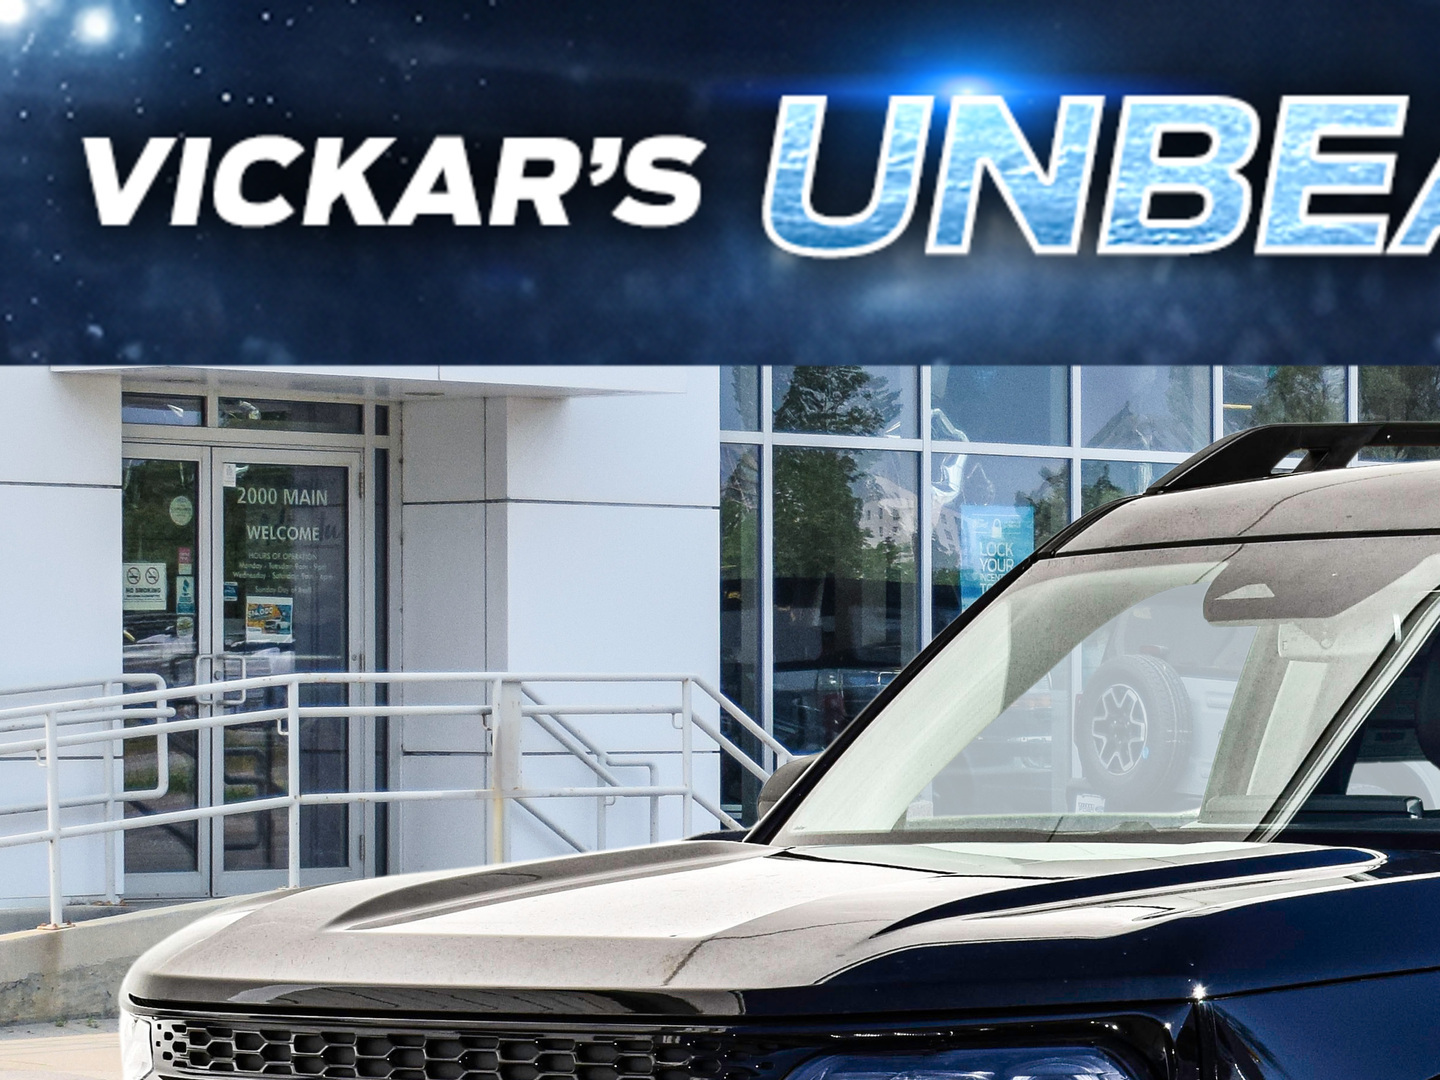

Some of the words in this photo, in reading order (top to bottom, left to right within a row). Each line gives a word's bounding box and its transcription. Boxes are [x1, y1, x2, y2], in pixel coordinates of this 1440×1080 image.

[237, 487, 277, 504] 2000
[283, 488, 328, 506] MAIN
[246, 524, 320, 541] WELCOME
[248, 552, 271, 560] HOURS
[980, 541, 1014, 557] LOCK
[980, 558, 1015, 572] YOUR
